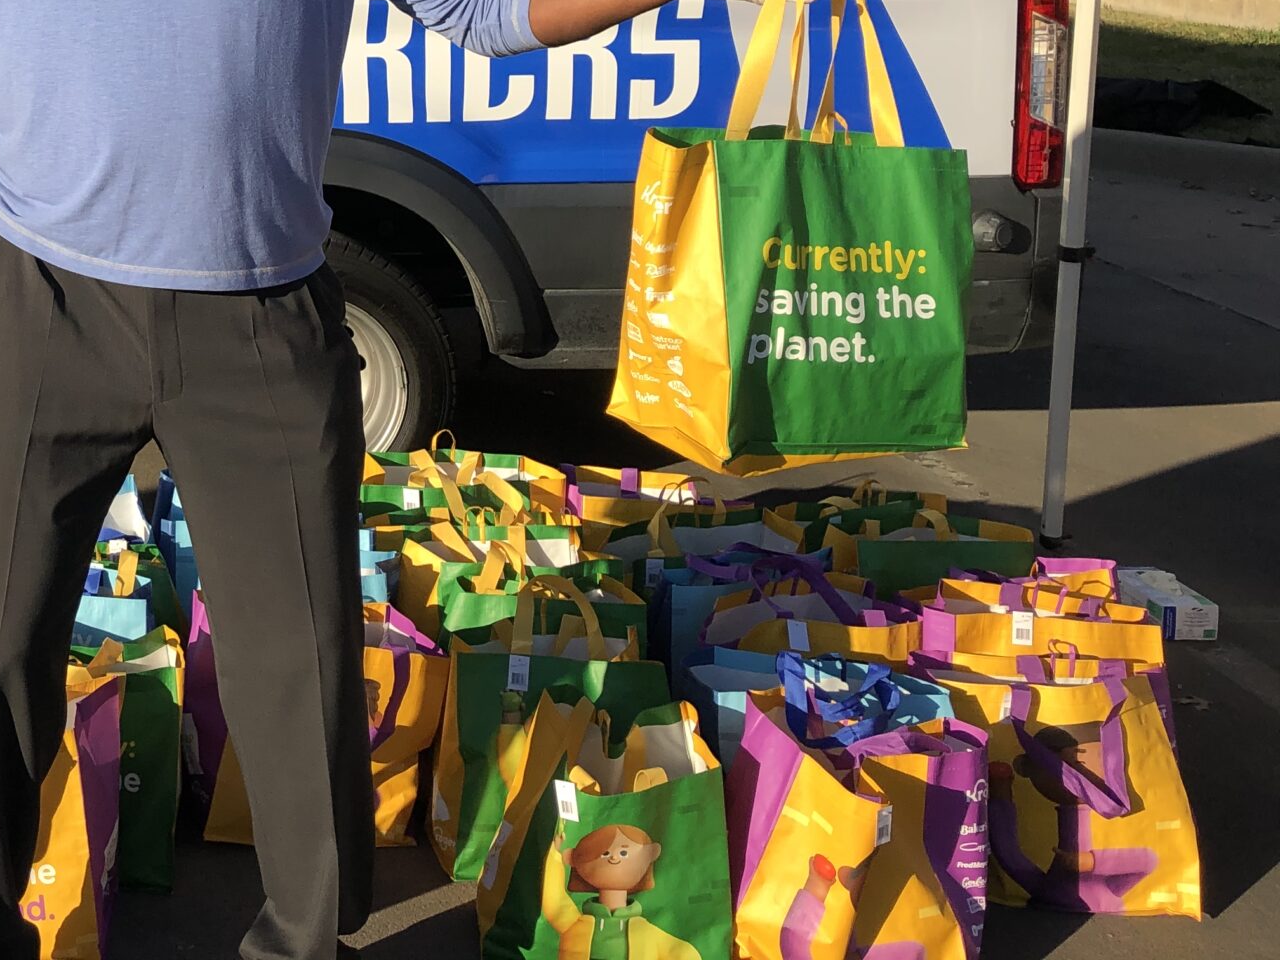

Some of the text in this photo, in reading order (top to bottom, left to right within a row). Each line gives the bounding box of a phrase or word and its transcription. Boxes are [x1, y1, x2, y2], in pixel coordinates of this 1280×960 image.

[762, 237, 928, 280] Currently:
[755, 283, 937, 325] saving the
[747, 326, 876, 365] planet.
